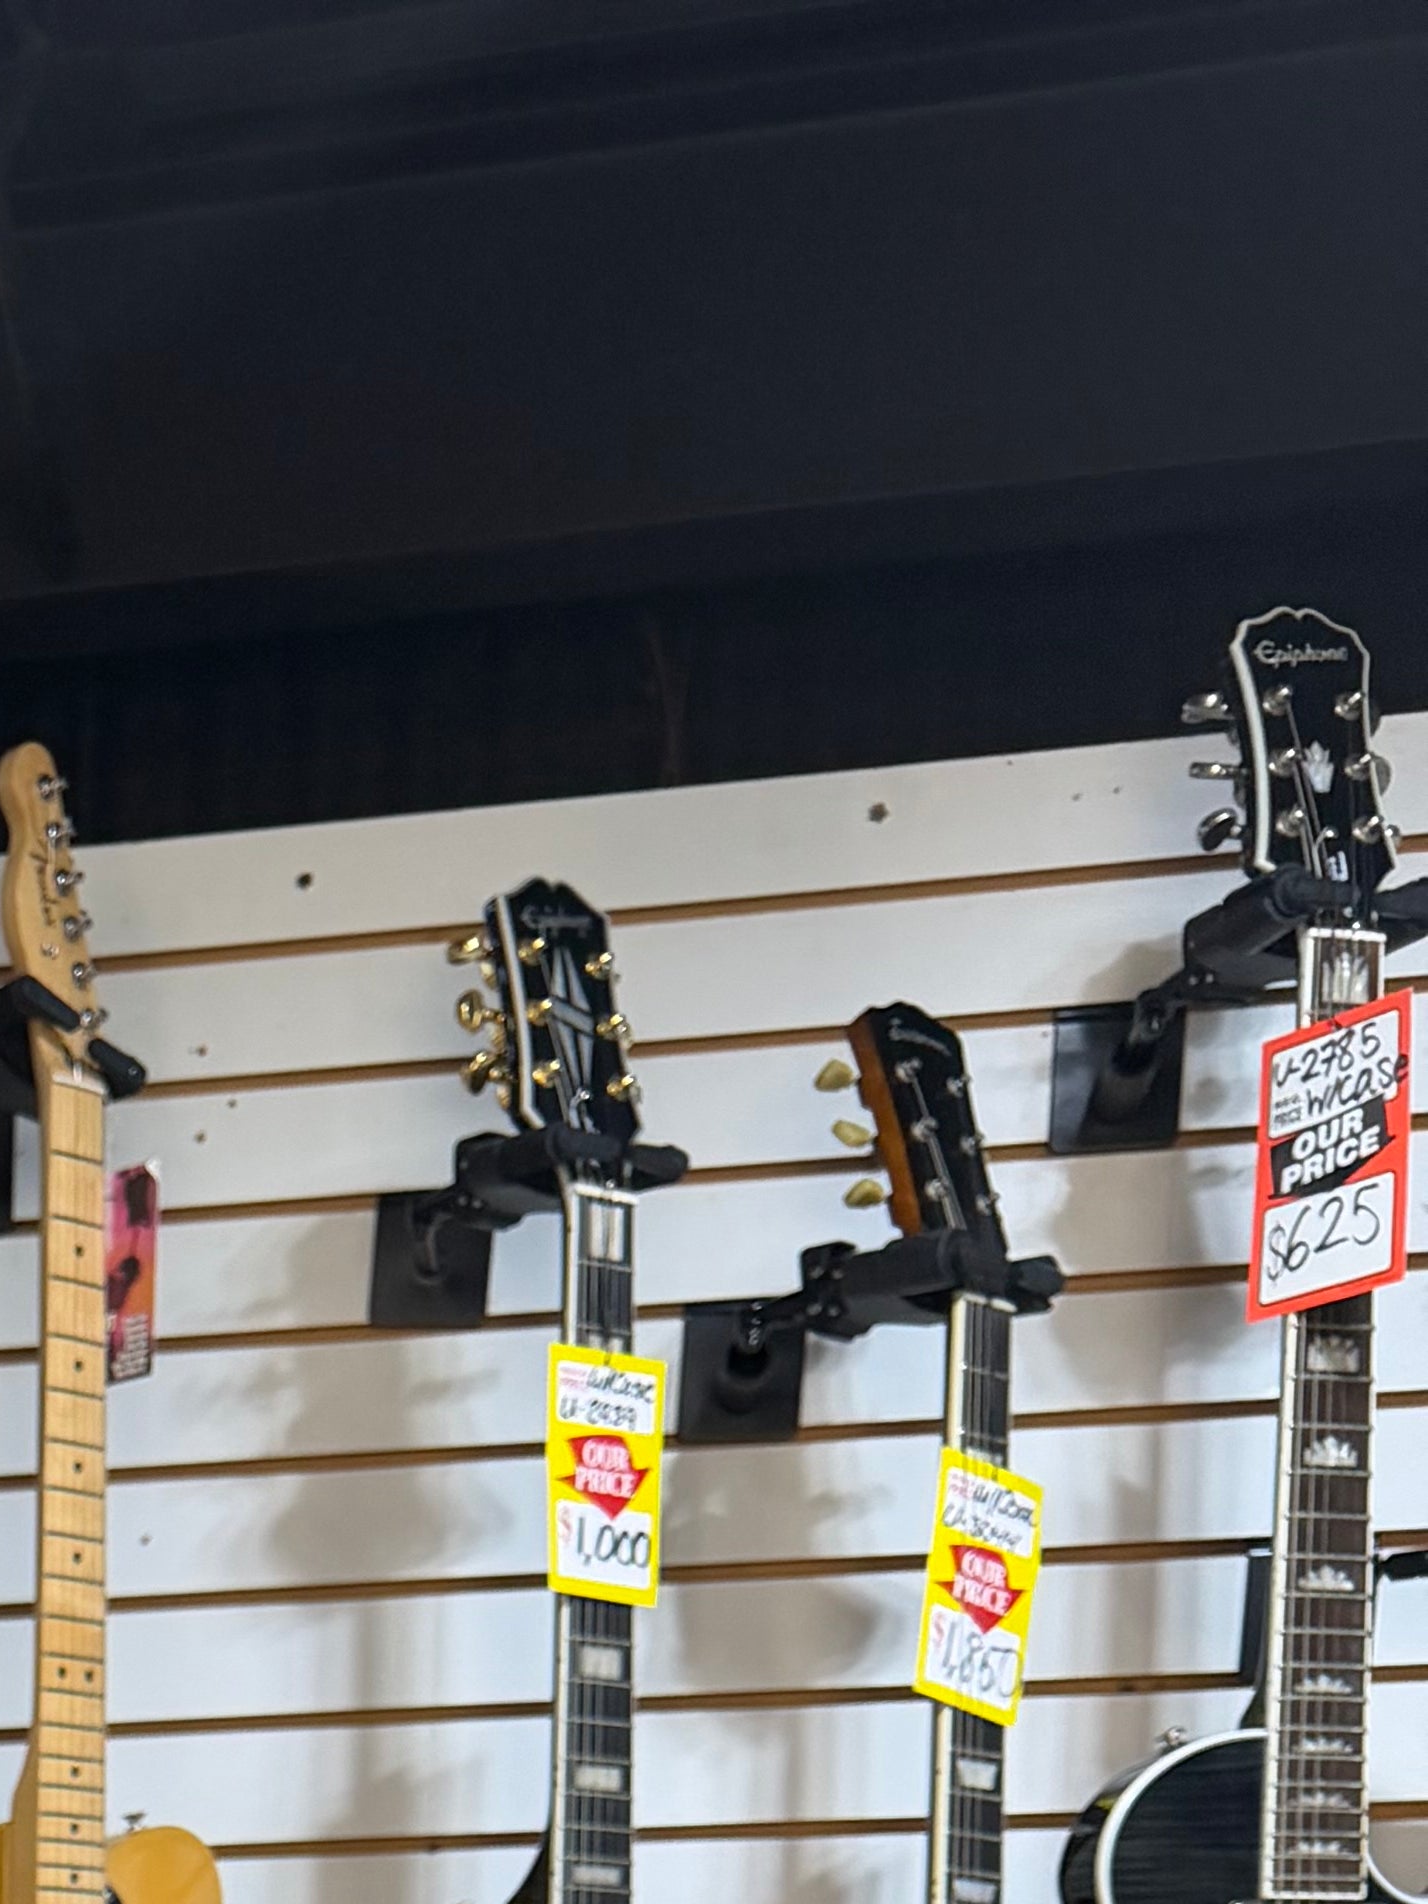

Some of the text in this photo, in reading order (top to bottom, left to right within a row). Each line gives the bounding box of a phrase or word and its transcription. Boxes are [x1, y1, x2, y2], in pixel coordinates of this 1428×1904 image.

[1292, 1108, 1363, 1160] OUR
[1280, 1125, 1380, 1194] PRICE
[1268, 1184, 1381, 1287] $625
[582, 1438, 631, 1472] OUR
[574, 1465, 637, 1500] PRICE
[559, 1506, 652, 1569] $1,000
[961, 1549, 1008, 1590] OUR
[951, 1573, 1013, 1617] PRICE
